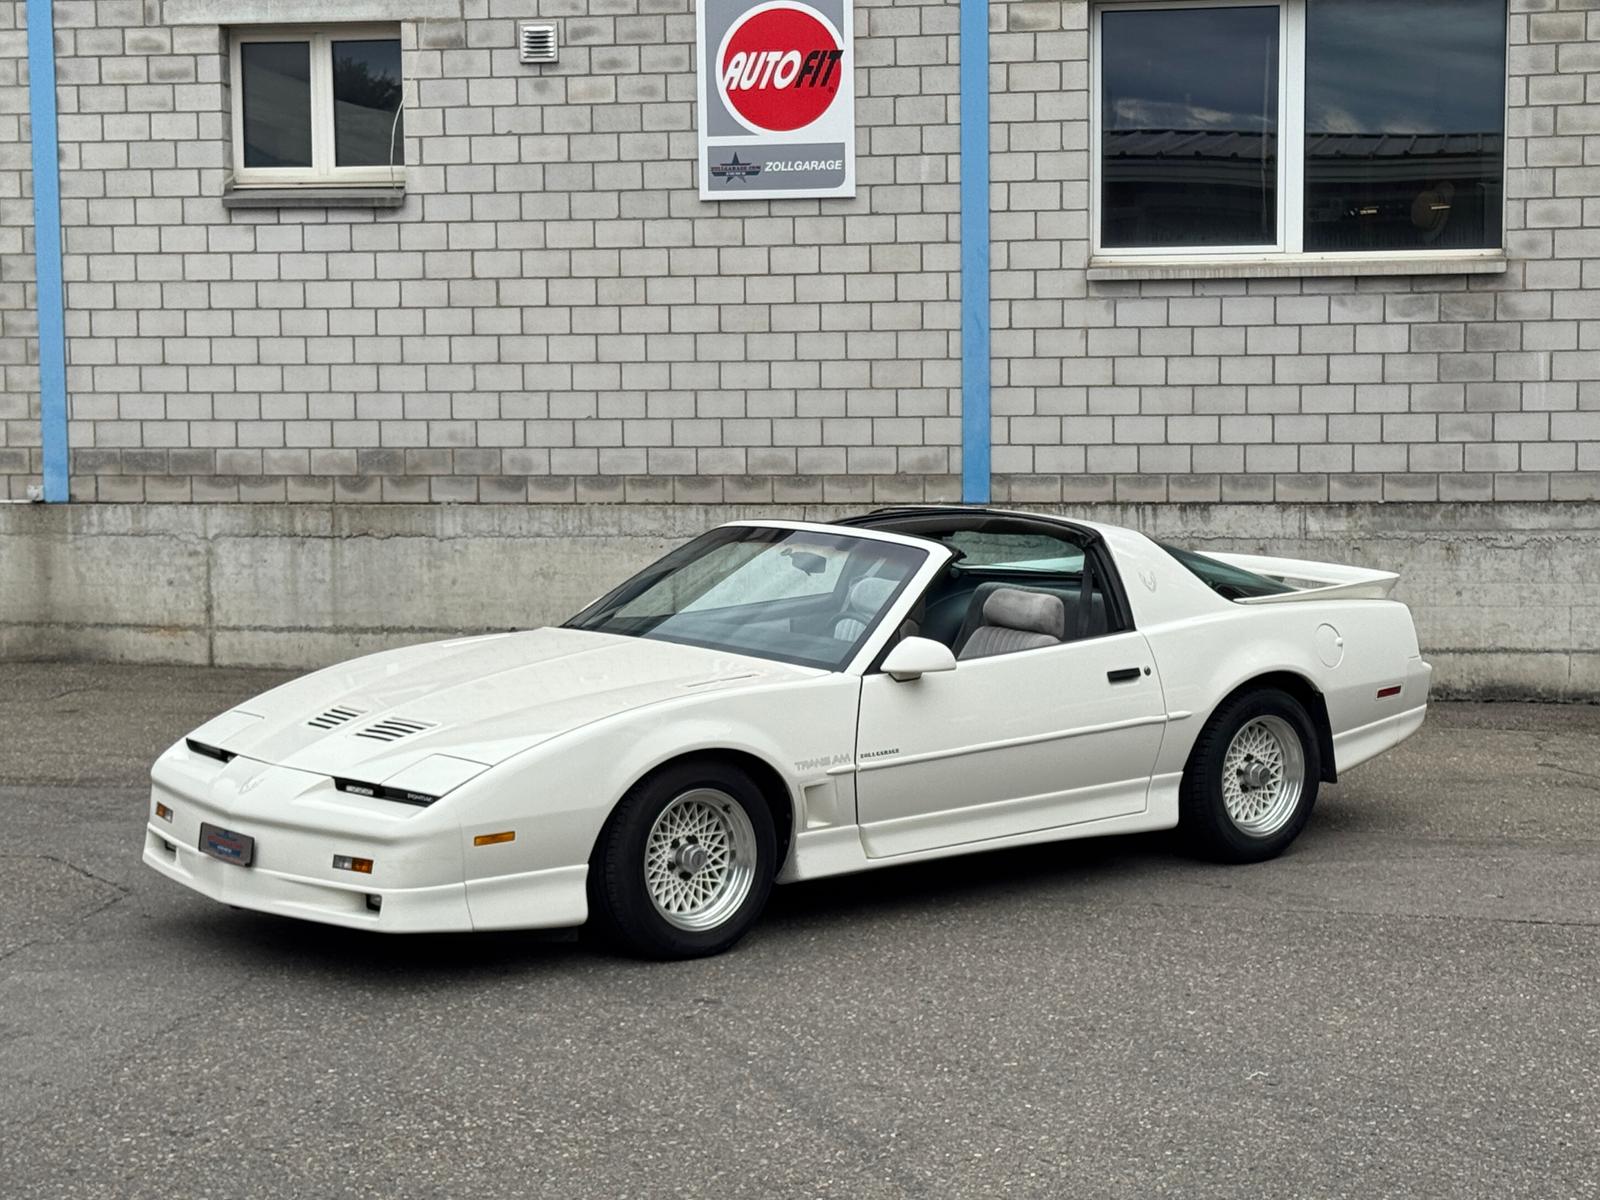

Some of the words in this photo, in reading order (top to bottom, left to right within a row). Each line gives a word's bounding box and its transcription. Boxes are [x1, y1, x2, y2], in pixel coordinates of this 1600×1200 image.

[723, 49, 844, 91] AUTOFIT
[764, 160, 843, 172] ZOLLGARAGE
[831, 753, 851, 765] AM
